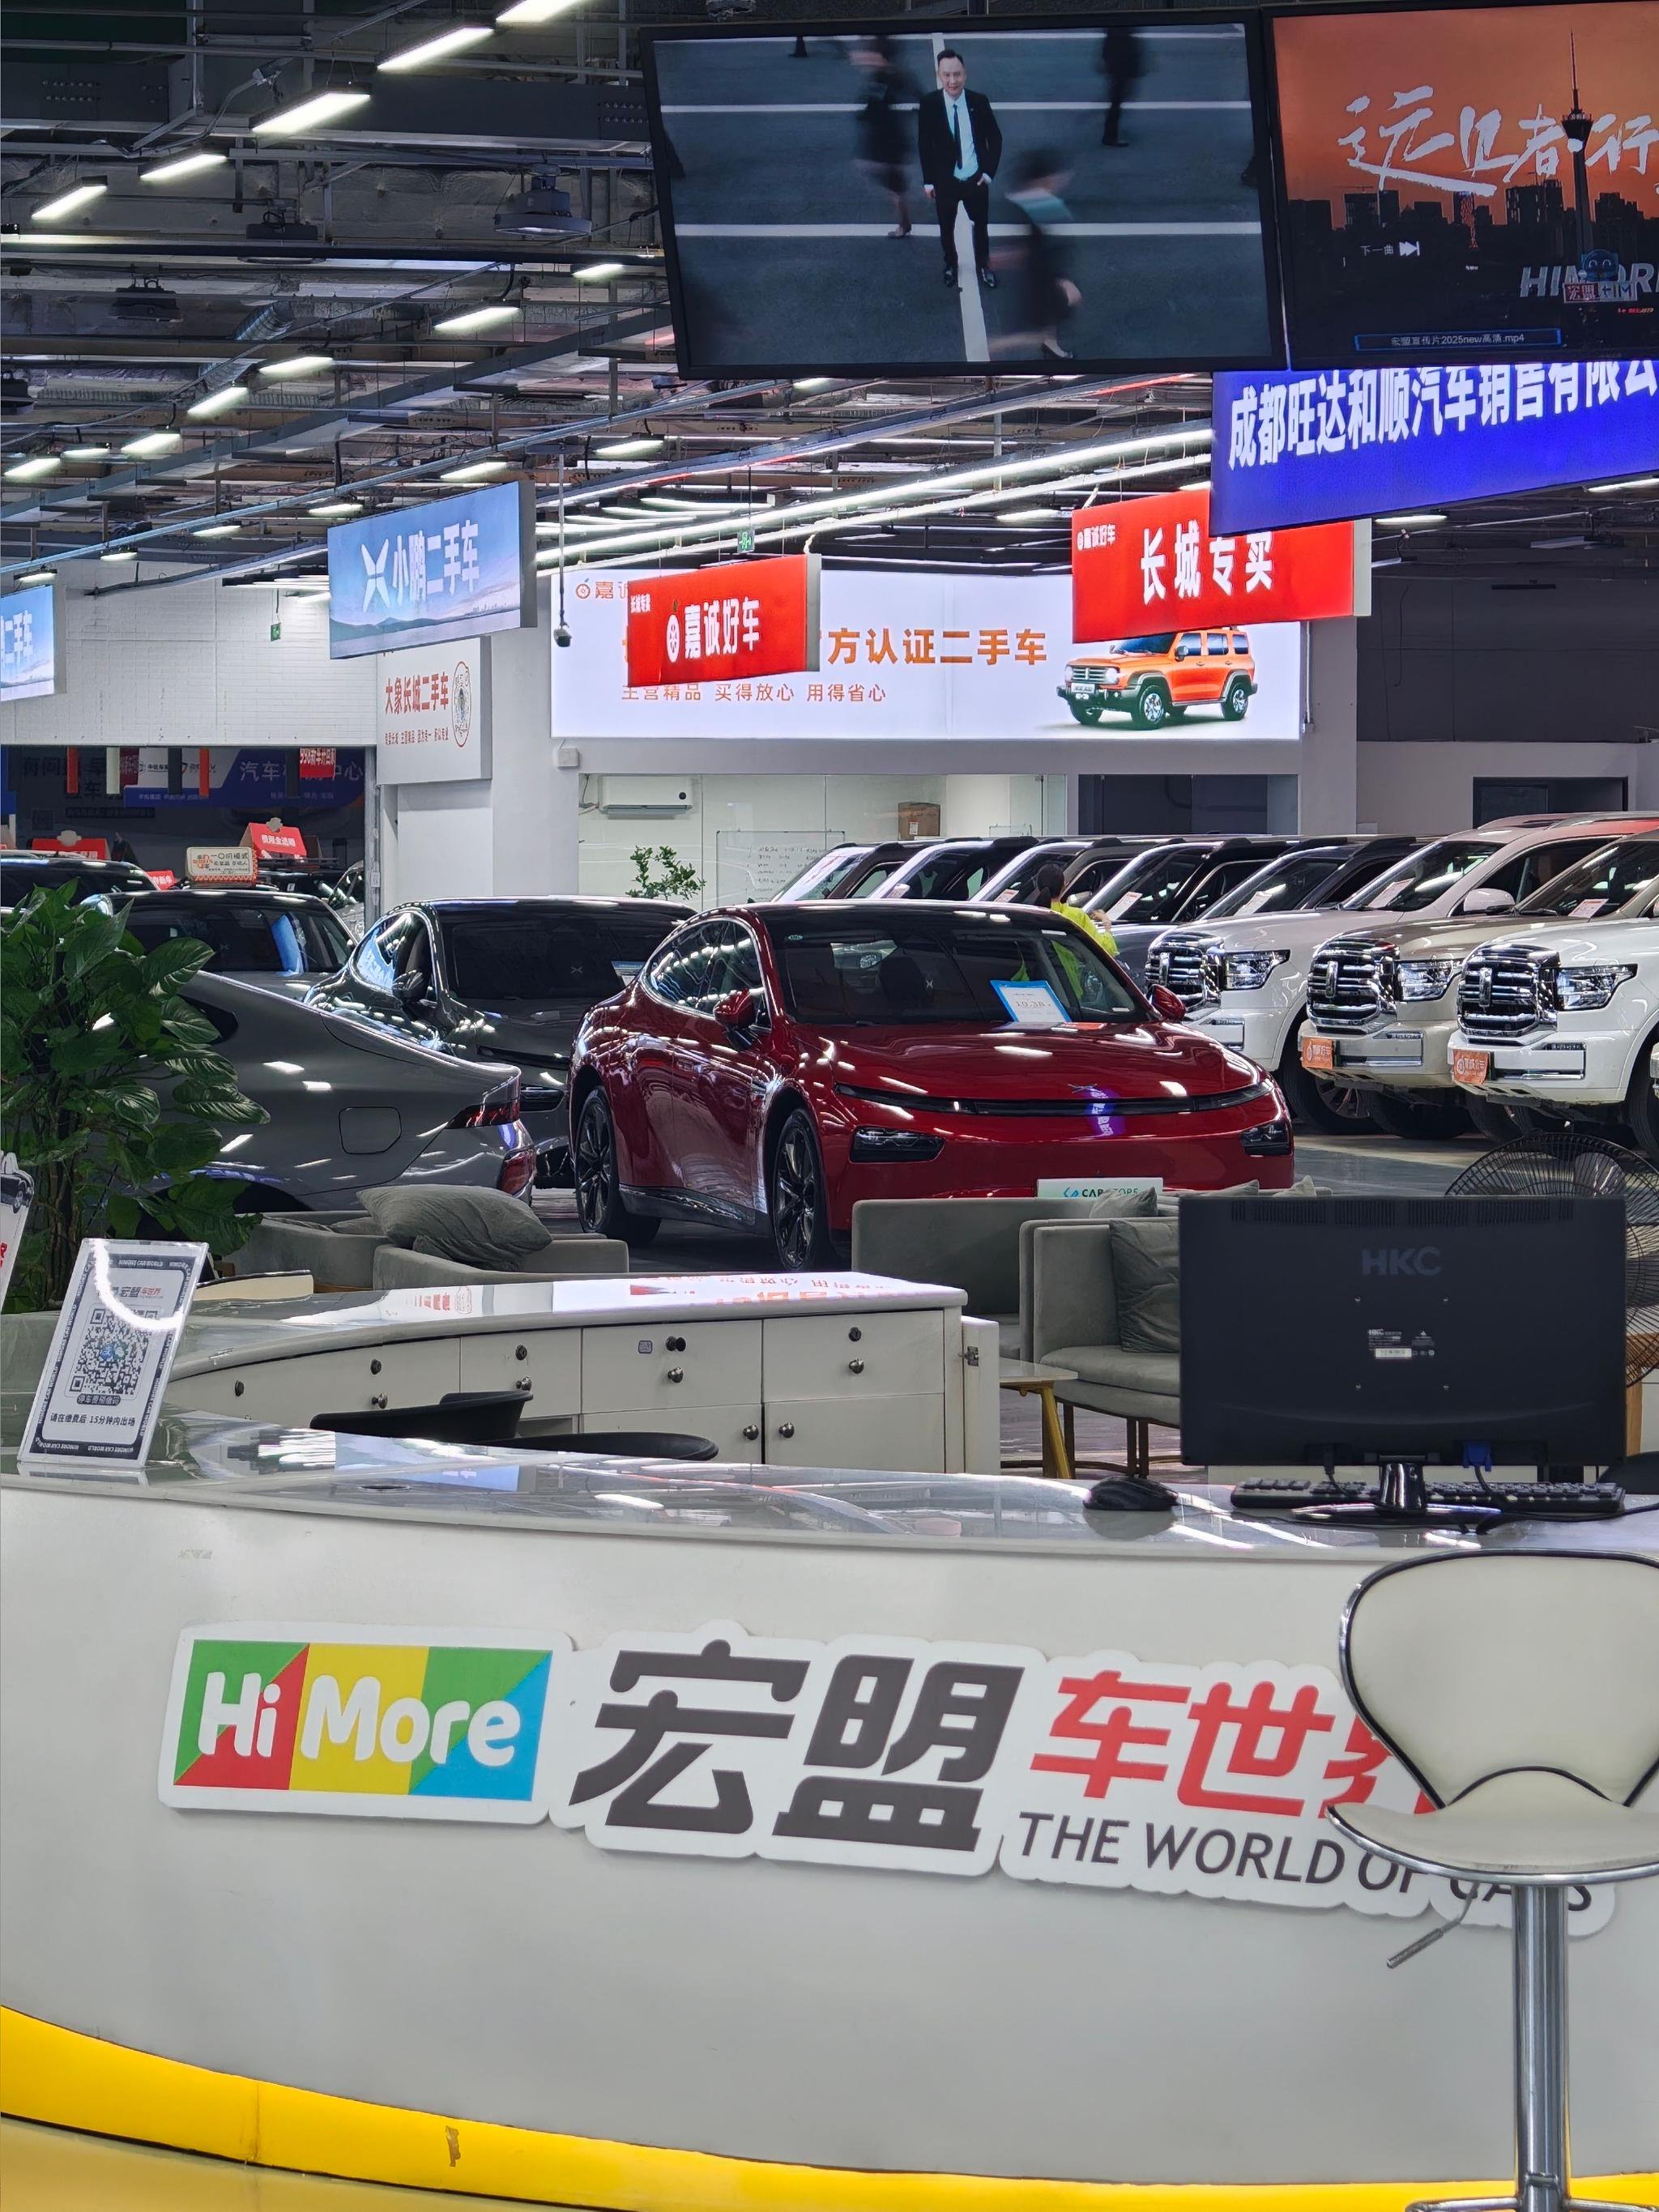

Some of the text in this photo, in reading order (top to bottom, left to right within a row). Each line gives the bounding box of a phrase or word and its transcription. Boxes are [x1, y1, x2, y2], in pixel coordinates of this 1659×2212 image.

[1361, 245, 1393, 255] 下一曲
[392, 519, 480, 606] 小鹏二手车
[595, 581, 629, 599] 嘉
[0, 610, 33, 667] 二手车
[684, 597, 760, 659] 嘉诚好车
[819, 628, 1047, 666] 方认证二手车
[385, 671, 449, 715] 大象长城二手车
[714, 683, 794, 701] 买得放心
[807, 684, 886, 702] 用得省心
[1362, 1247, 1442, 1276] HKC
[50, 1413, 135, 1426] 请在缴费后 15分钟内出场
[568, 1639, 1440, 1852] 宏盟 车世
[1018, 1811, 1131, 1865] THE
[1145, 1822, 1346, 1884] WORLD
